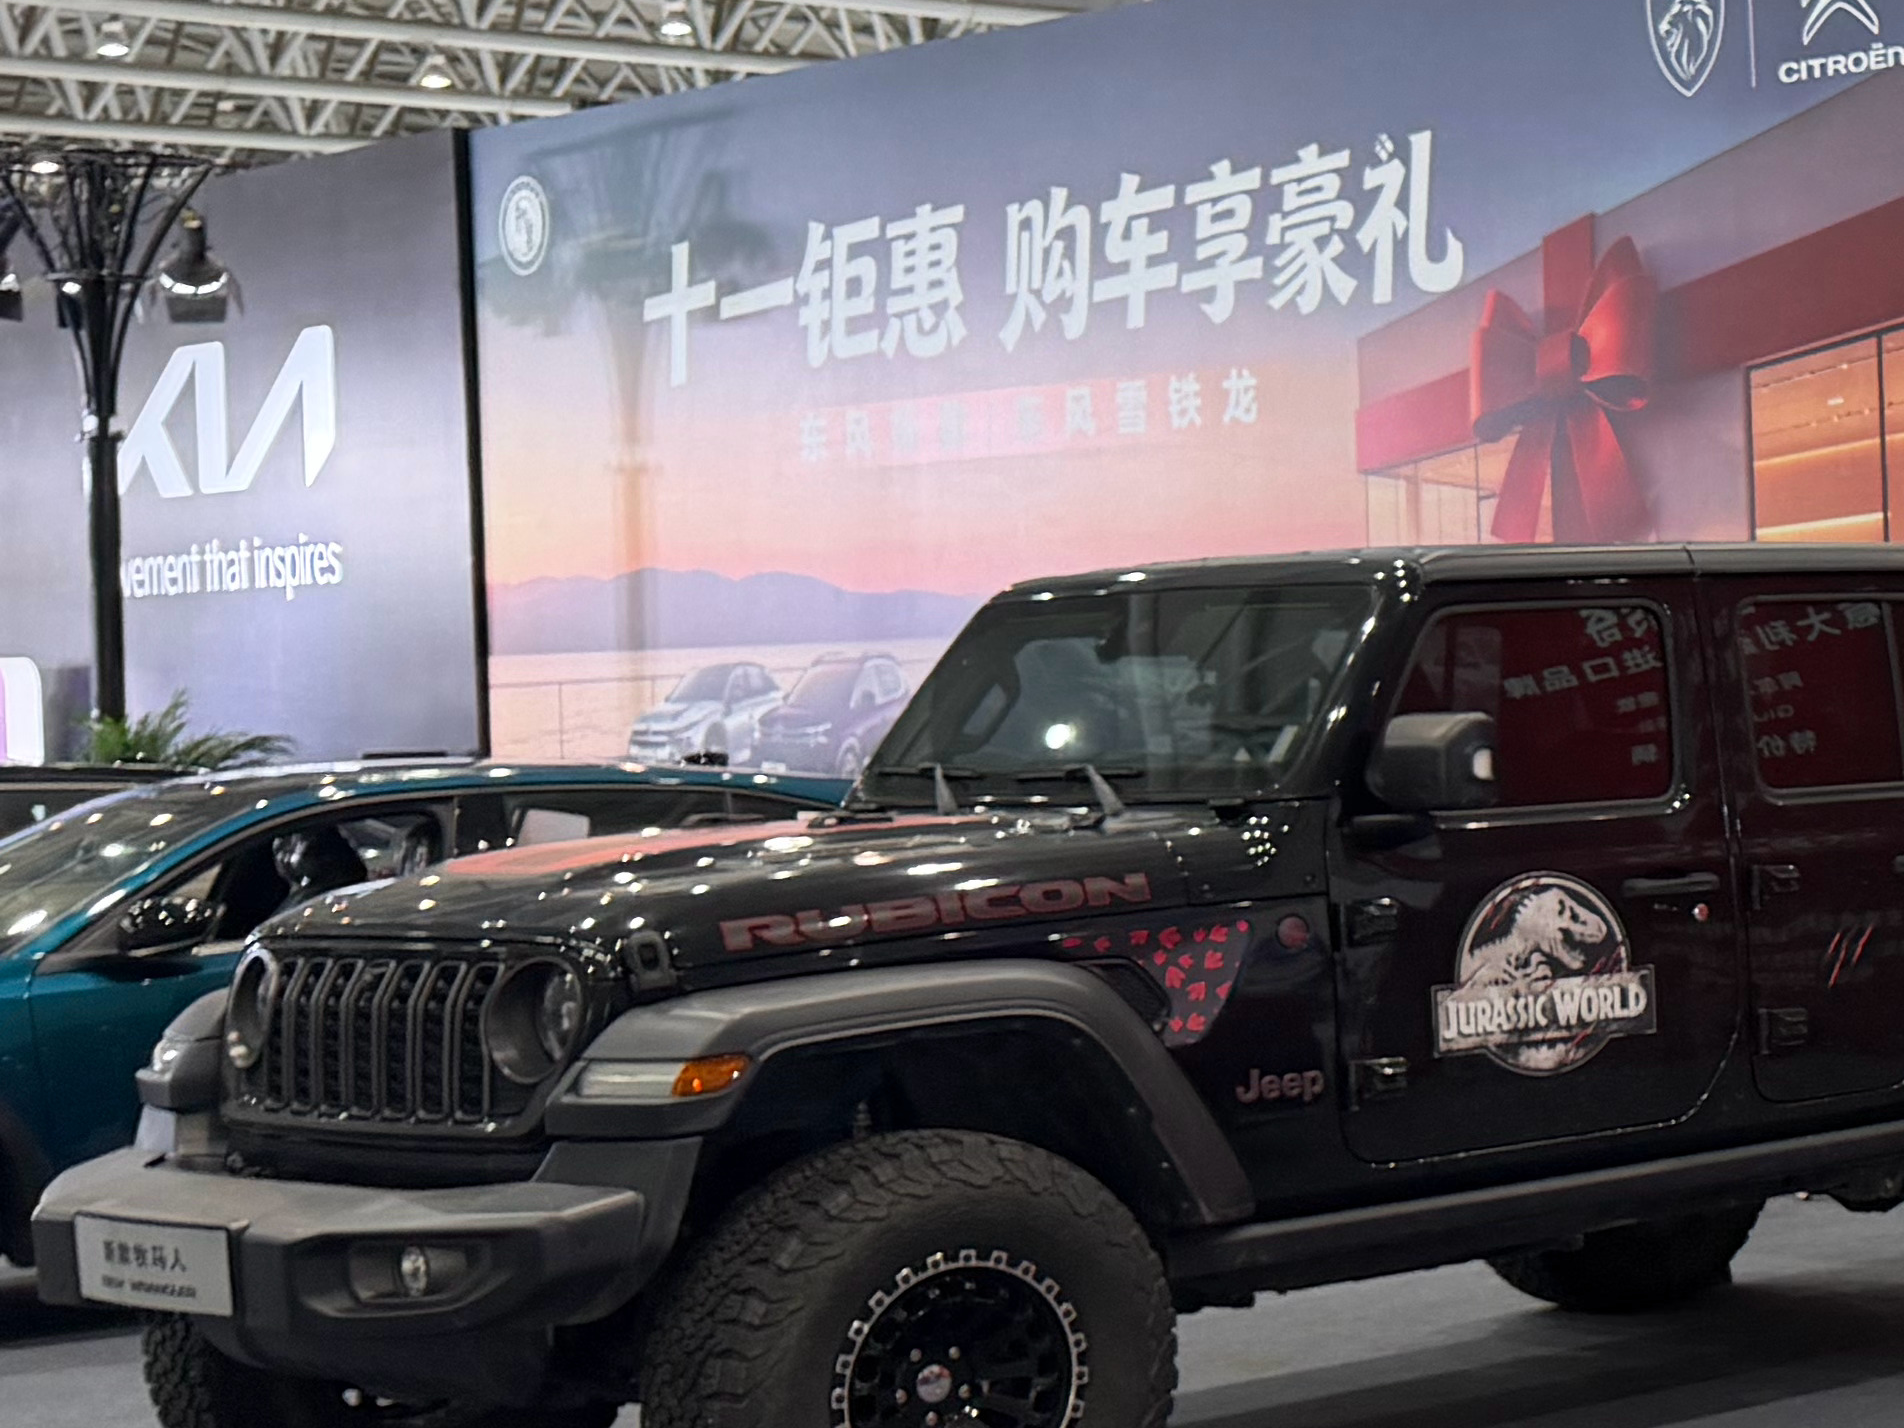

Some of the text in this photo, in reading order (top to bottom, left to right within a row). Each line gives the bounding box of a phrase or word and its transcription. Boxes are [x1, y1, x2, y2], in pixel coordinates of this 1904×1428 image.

[642, 203, 968, 388] 十一钜惠
[997, 129, 1464, 353] 购车享豪礼
[202, 537, 250, 593] that
[252, 531, 344, 602] inspires
[718, 872, 1152, 952] RUBICON
[1441, 982, 1649, 1040] JURASSIC WORLD
[1235, 1068, 1324, 1104] Jeep
